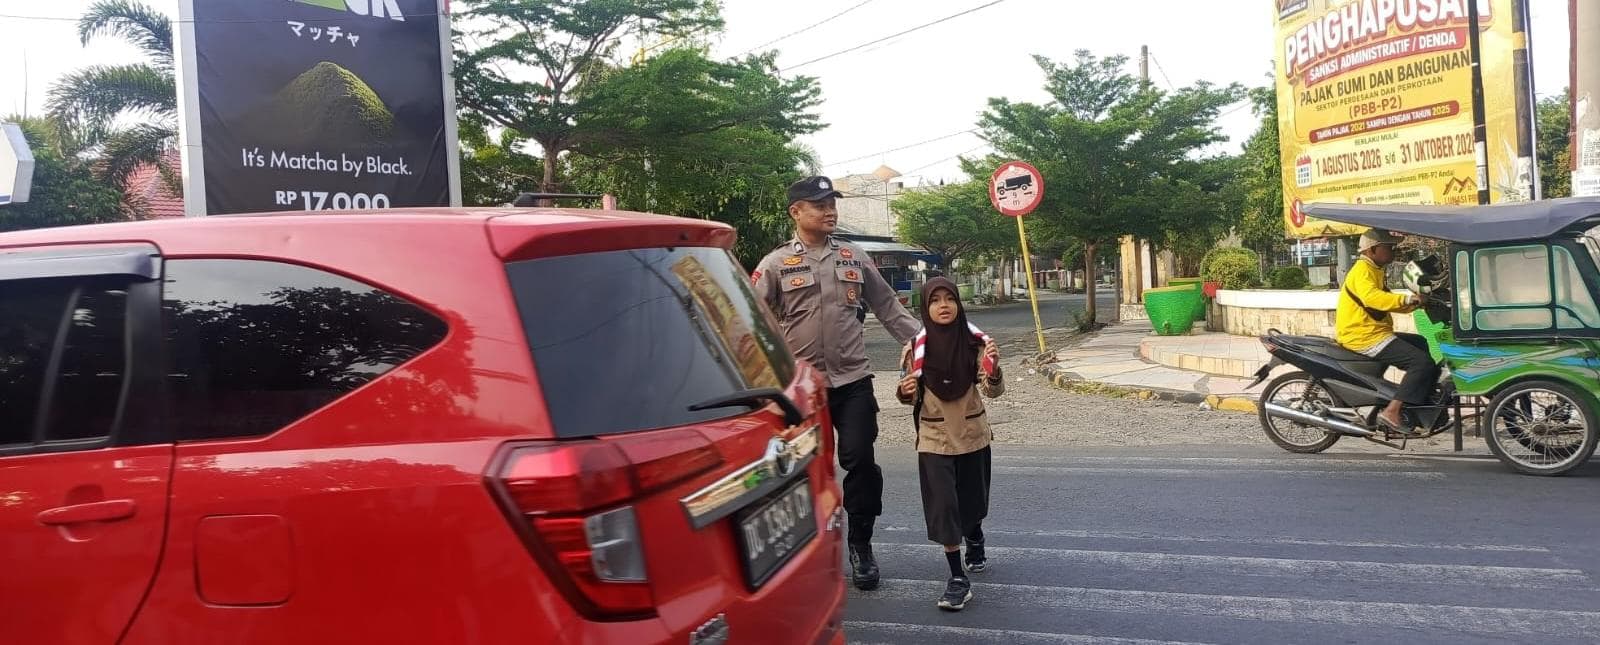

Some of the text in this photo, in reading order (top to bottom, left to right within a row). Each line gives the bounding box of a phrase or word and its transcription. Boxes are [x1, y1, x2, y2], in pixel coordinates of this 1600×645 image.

[287, 20, 360, 47] マッチャ
[1309, 60, 1338, 81] SANKSI
[1341, 37, 1410, 69] ADMINISTRATIF
[1418, 31, 1457, 49] DENDA
[1301, 49, 1471, 106] PAJAK BUMI DAN BANGUNAN
[1380, 86, 1396, 96] DAN
[1397, 75, 1444, 91] PERKOTAAN
[1349, 95, 1402, 119] (PBB-P2)
[1387, 112, 1411, 124] DENGAN
[1412, 109, 1432, 120] TAHUN
[242, 147, 413, 178] It's Matcha by Black.
[1316, 158, 1320, 177] 1
[1322, 152, 1359, 176] AGUSTUS
[1360, 148, 1382, 170] 2026
[1400, 143, 1412, 164] 31
[1414, 135, 1455, 162] OKTOBER
[275, 190, 390, 211] RP 17.000
